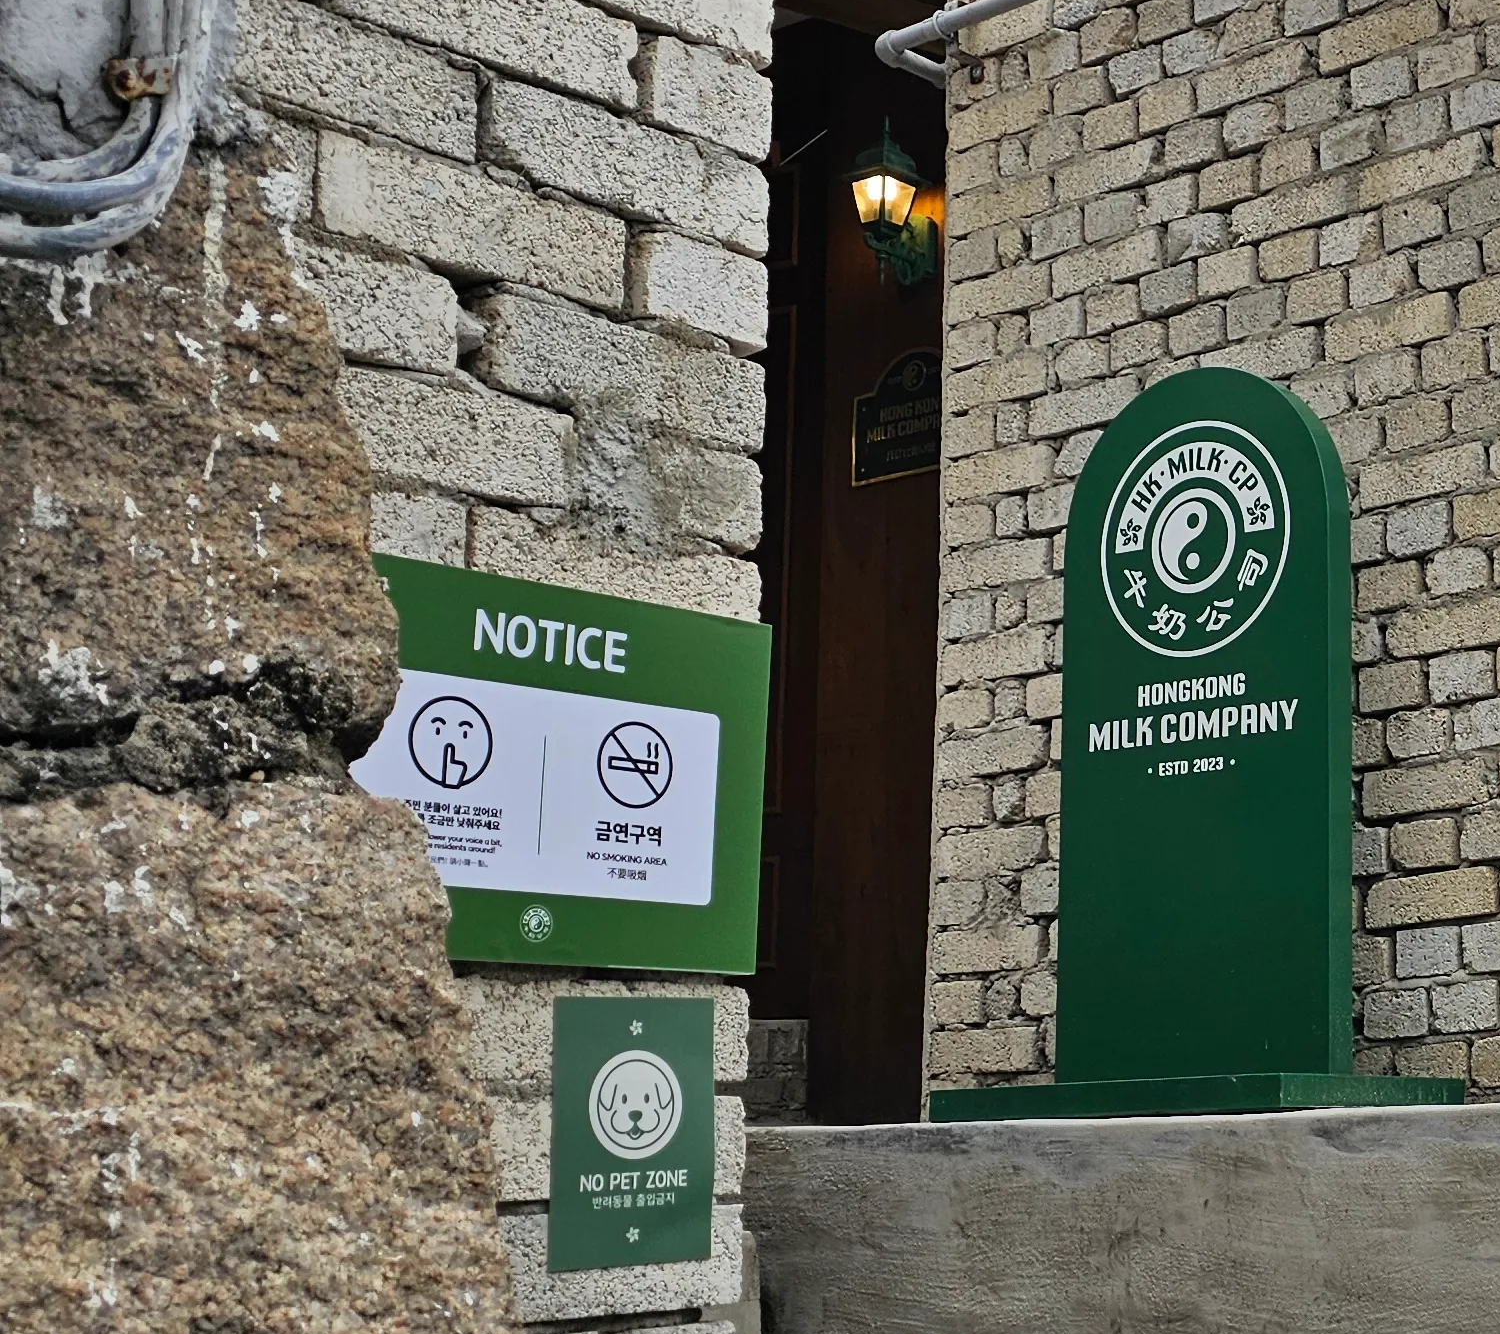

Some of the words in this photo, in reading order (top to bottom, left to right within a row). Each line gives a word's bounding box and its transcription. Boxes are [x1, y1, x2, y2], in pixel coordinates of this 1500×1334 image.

[914, 396, 939, 416] KON
[897, 413, 940, 437] COMPA
[473, 607, 628, 675] NOTICE
[1137, 672, 1246, 708] HONGKONG
[1088, 715, 1154, 753] MILK
[1160, 698, 1299, 744] COMPANY
[1158, 760, 1189, 777] ESTD
[1192, 756, 1224, 774] 2023
[595, 820, 662, 847] 금연구역
[587, 851, 601, 860] NO
[602, 852, 642, 864] SMOKING
[643, 856, 668, 866] AREA
[579, 1173, 605, 1192] NO
[609, 1171, 641, 1191] PET
[646, 1169, 688, 1188] ZONE
